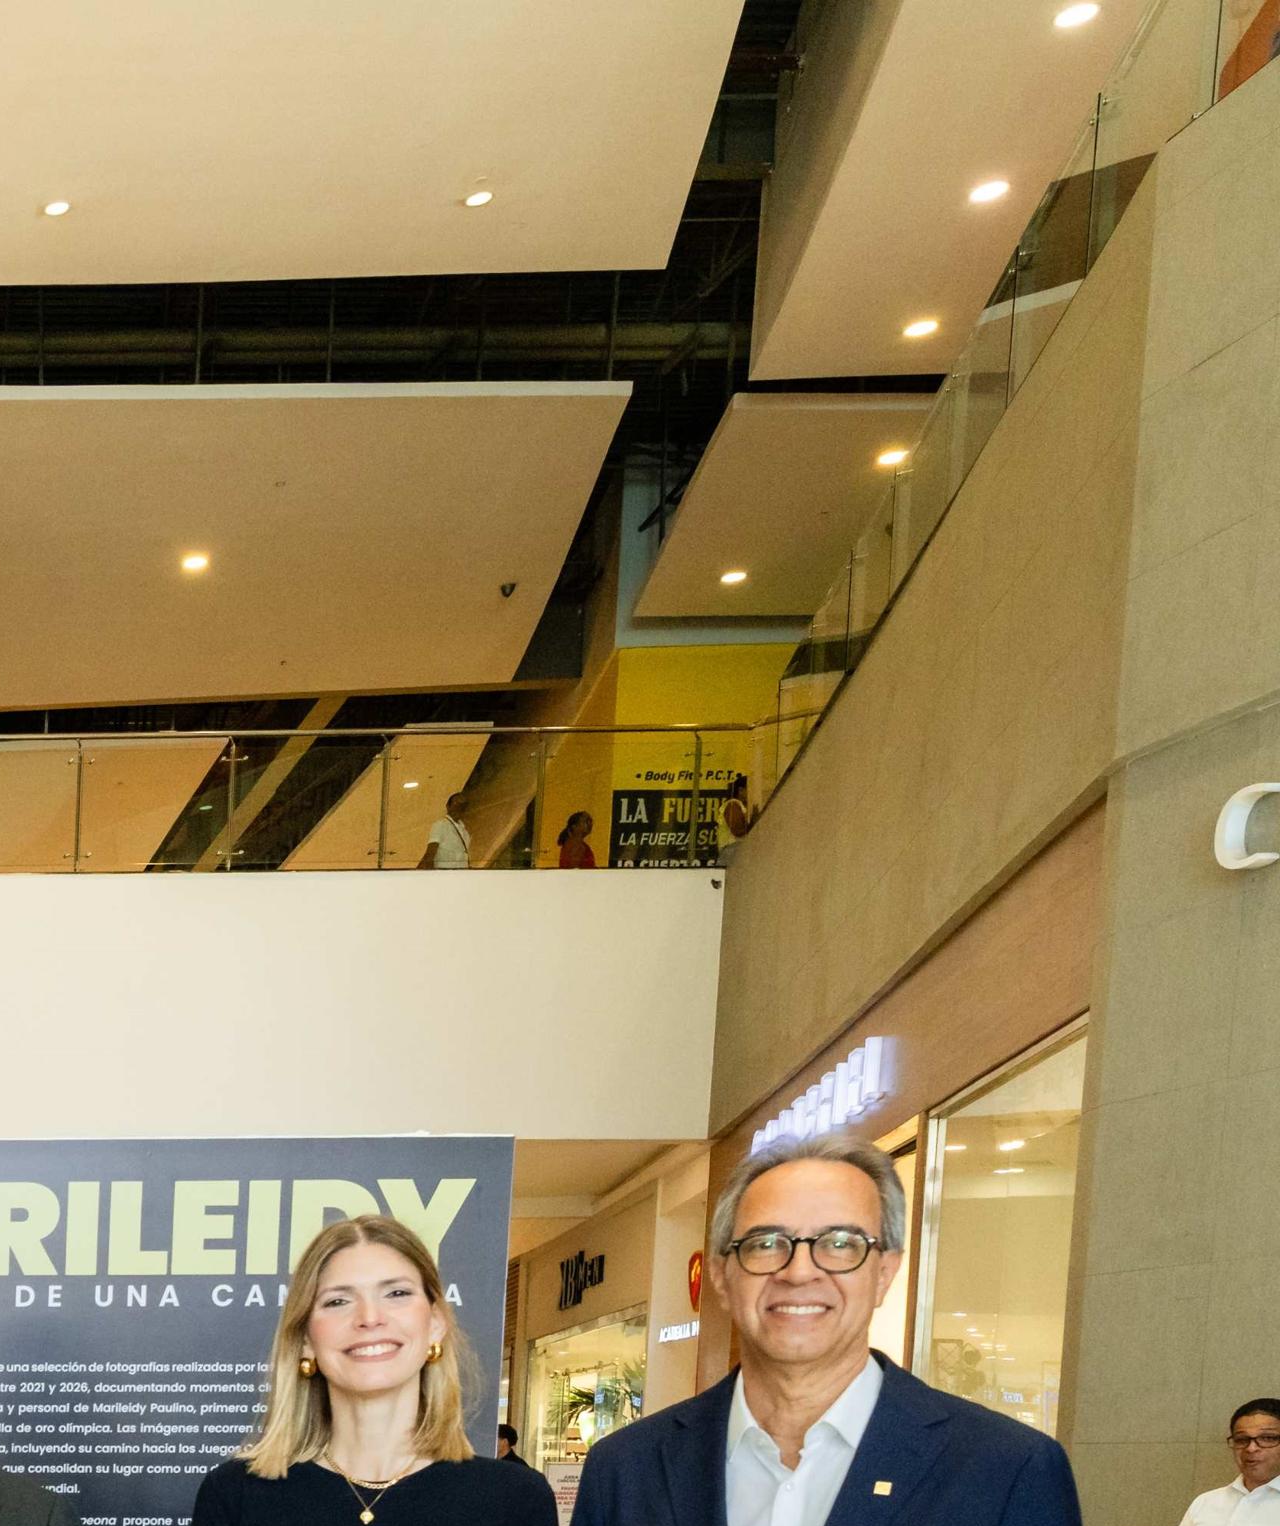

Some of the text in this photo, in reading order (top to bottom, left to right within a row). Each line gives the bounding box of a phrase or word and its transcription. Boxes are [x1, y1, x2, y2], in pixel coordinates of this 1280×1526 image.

[645, 771, 675, 783] Body
[619, 797, 725, 823] LA FUER
[619, 833, 636, 845] LA
[15, 1285, 62, 1308] DE
[95, 1284, 180, 1307] UNA
[6, 1363, 29, 1373] una
[31, 1361, 87, 1373] selección
[88, 1362, 104, 1373] de
[106, 1361, 170, 1375] fotografías
[172, 1361, 233, 1373] realizadas
[235, 1364, 255, 1375] por
[20, 1382, 45, 1393] 2021
[48, 1384, 57, 1395] y
[59, 1382, 91, 1394] 2026,
[94, 1382, 186, 1393] documentando
[190, 1383, 255, 1393] momentos
[7, 1404, 15, 1415] y
[18, 1402, 70, 1415] personal
[73, 1402, 89, 1413] de
[93, 1402, 146, 1415] Marileidy
[150, 1402, 197, 1414] Paulino,
[200, 1402, 248, 1415] primera
[16, 1423, 32, 1433] de
[35, 1425, 55, 1433] oro
[58, 1423, 113, 1436] olímpica.
[117, 1424, 137, 1433] Las
[140, 1422, 199, 1436] imágenes
[203, 1424, 253, 1433] recorren
[11, 1443, 76, 1456] incluyendo
[78, 1445, 93, 1454] su
[95, 1443, 140, 1454] camino
[143, 1443, 177, 1454] hacia
[179, 1443, 196, 1453] los
[28, 1463, 92, 1473] consolidan
[96, 1465, 110, 1474] su
[113, 1464, 144, 1476] lugar
[147, 1465, 181, 1474] como
[184, 1465, 208, 1474] una
